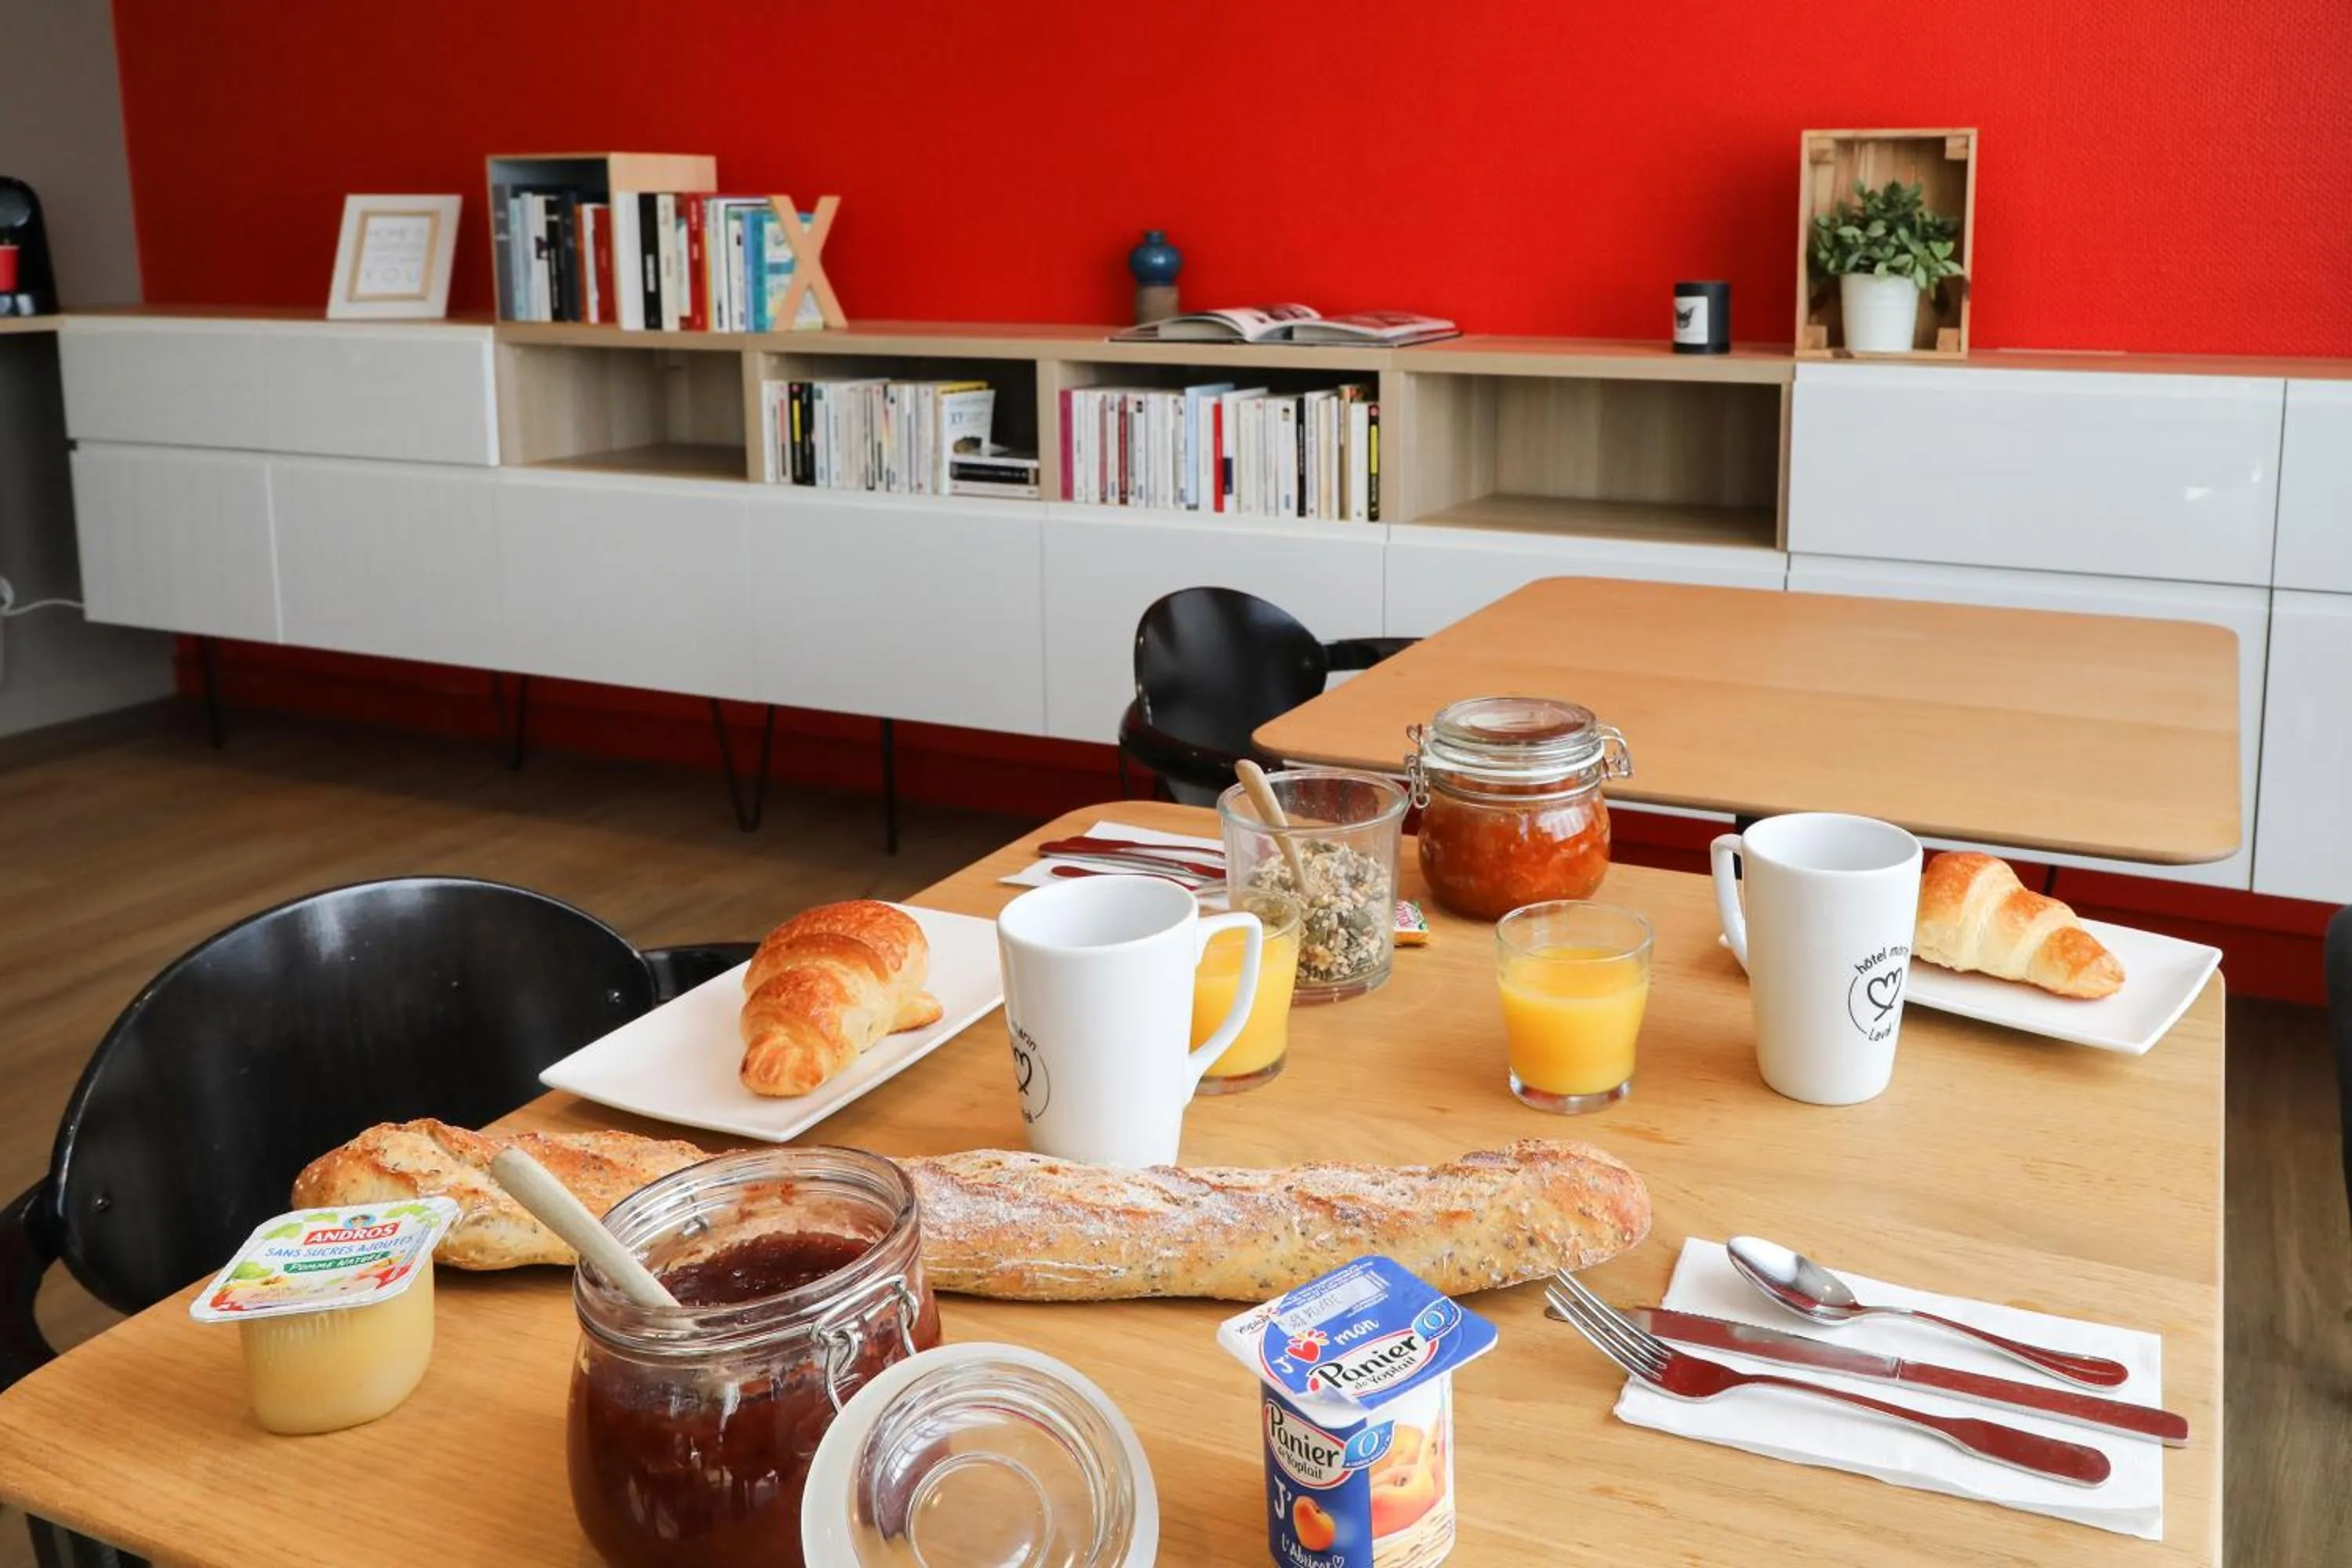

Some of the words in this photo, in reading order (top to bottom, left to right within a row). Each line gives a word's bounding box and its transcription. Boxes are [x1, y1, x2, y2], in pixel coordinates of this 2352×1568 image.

[1854, 947, 1886, 975] hôtel
[309, 1226, 395, 1243] ANDROS
[265, 1247, 302, 1258] SANS
[303, 1245, 354, 1258] SUCRES
[1334, 1319, 1380, 1345] mon
[1309, 1335, 1417, 1388] Panier
[1370, 1357, 1416, 1385] Yoplait
[1268, 1401, 1340, 1468] Panier
[1285, 1450, 1323, 1479] Yoplait
